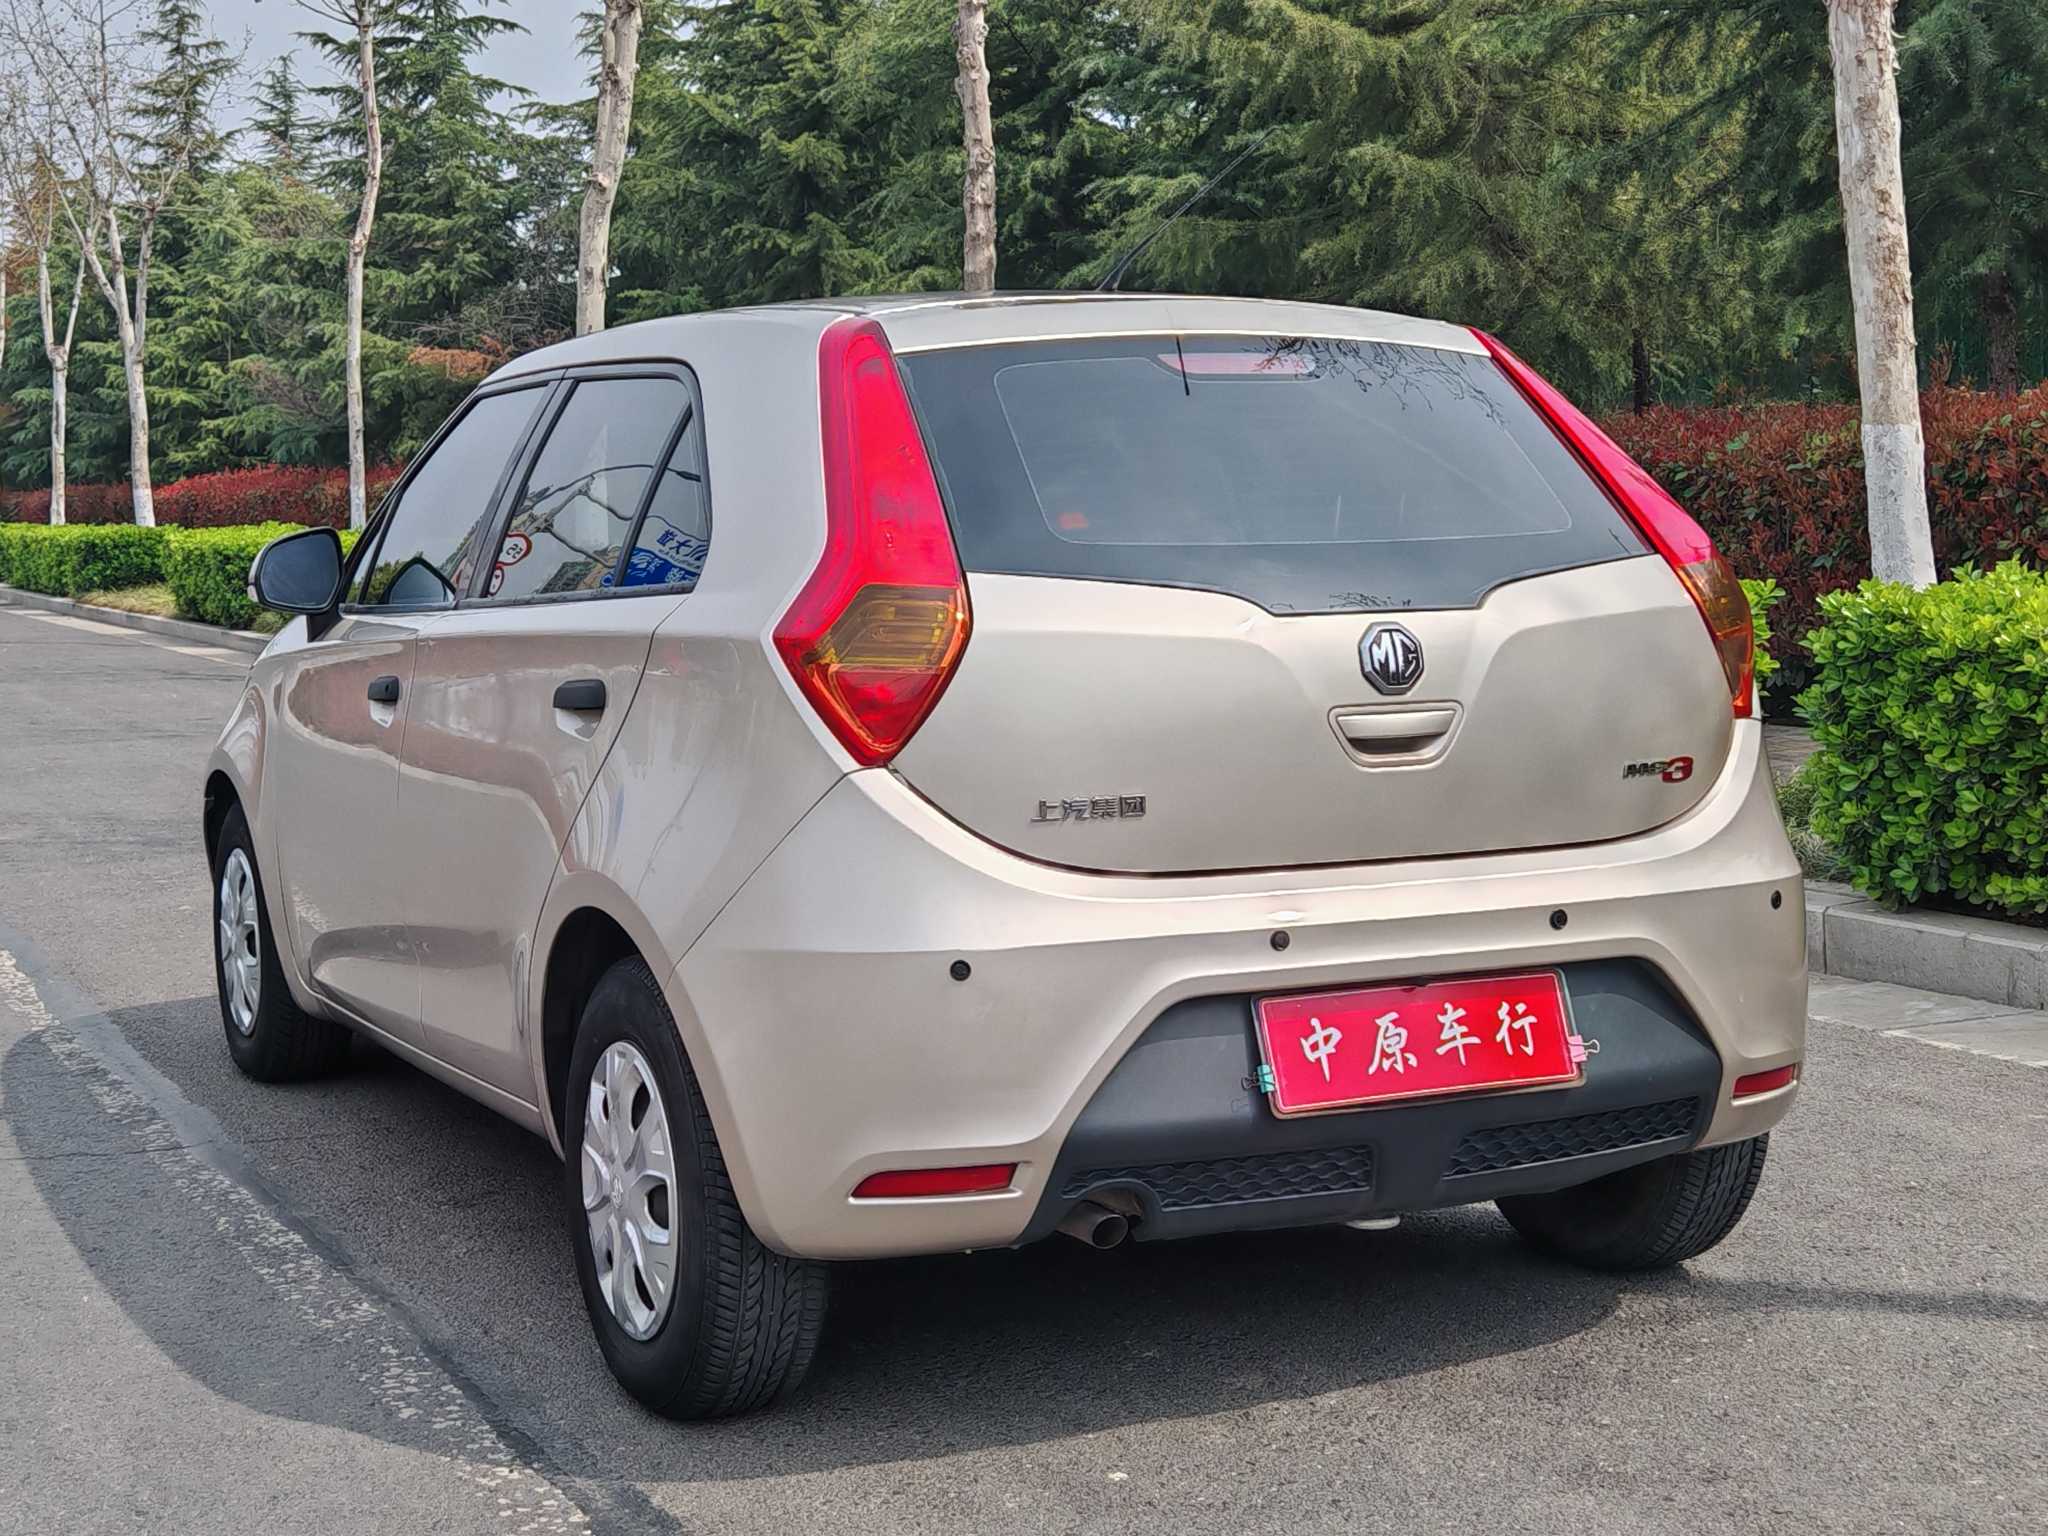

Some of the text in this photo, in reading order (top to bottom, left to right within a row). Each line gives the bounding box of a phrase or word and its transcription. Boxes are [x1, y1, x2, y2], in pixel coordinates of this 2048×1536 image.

[1371, 631, 1417, 683] MG
[1030, 794, 1147, 823] 上汽集团
[1299, 1000, 1539, 1083] 中原车行
